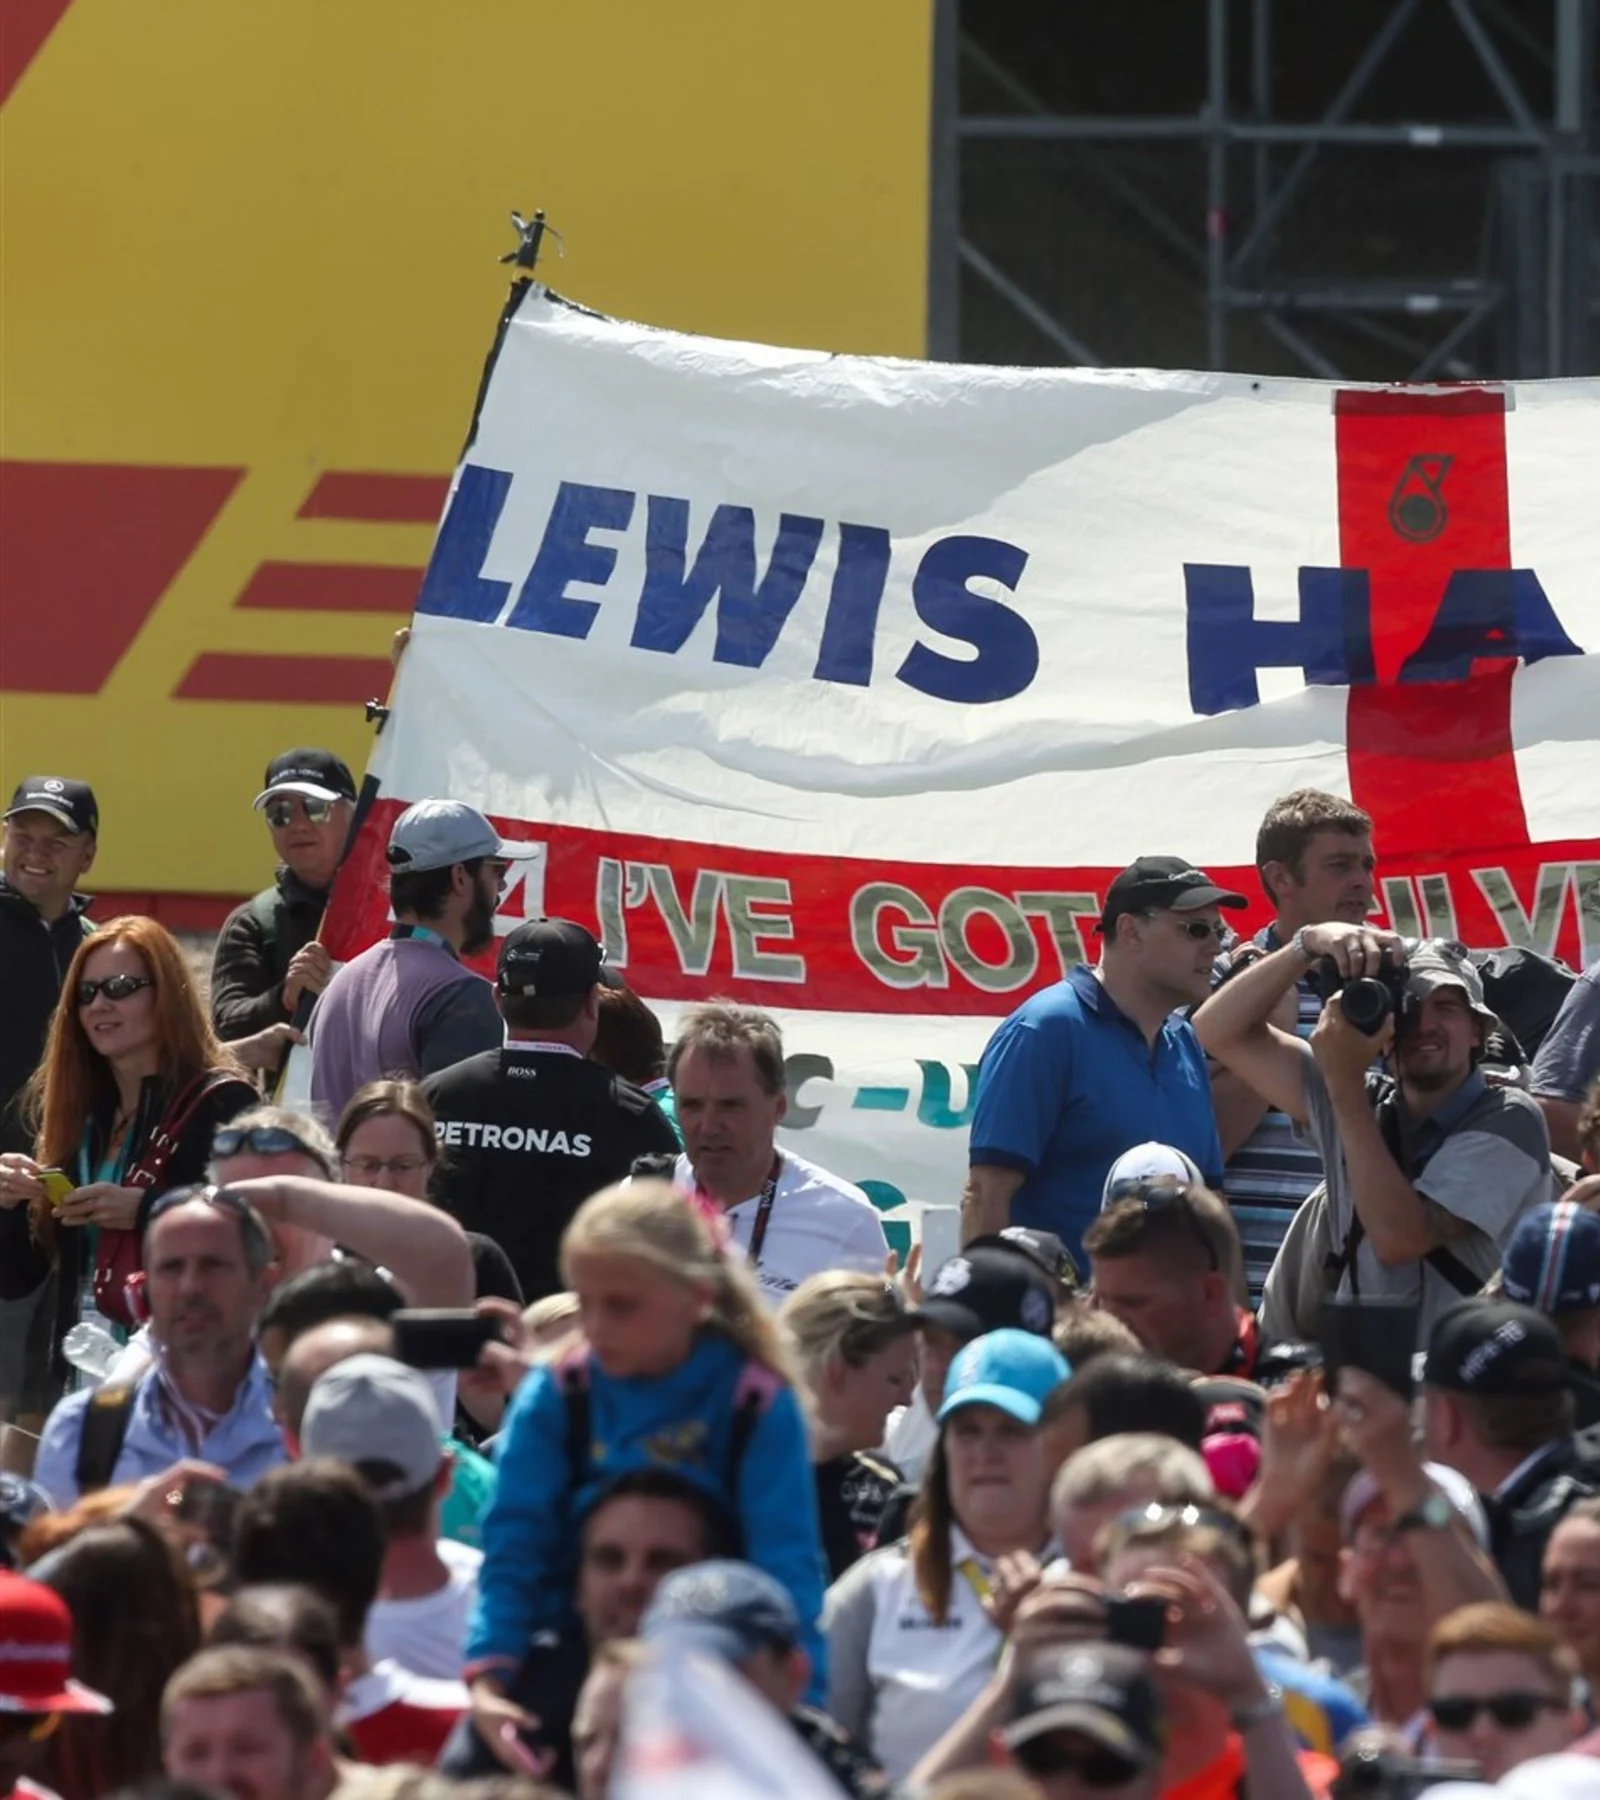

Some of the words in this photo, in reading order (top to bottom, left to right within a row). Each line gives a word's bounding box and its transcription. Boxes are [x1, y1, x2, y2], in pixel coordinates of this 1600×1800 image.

[413, 462, 1040, 705] LEWIS
[595, 855, 807, 984] I'VE
[506, 1065, 538, 1077] BOSS
